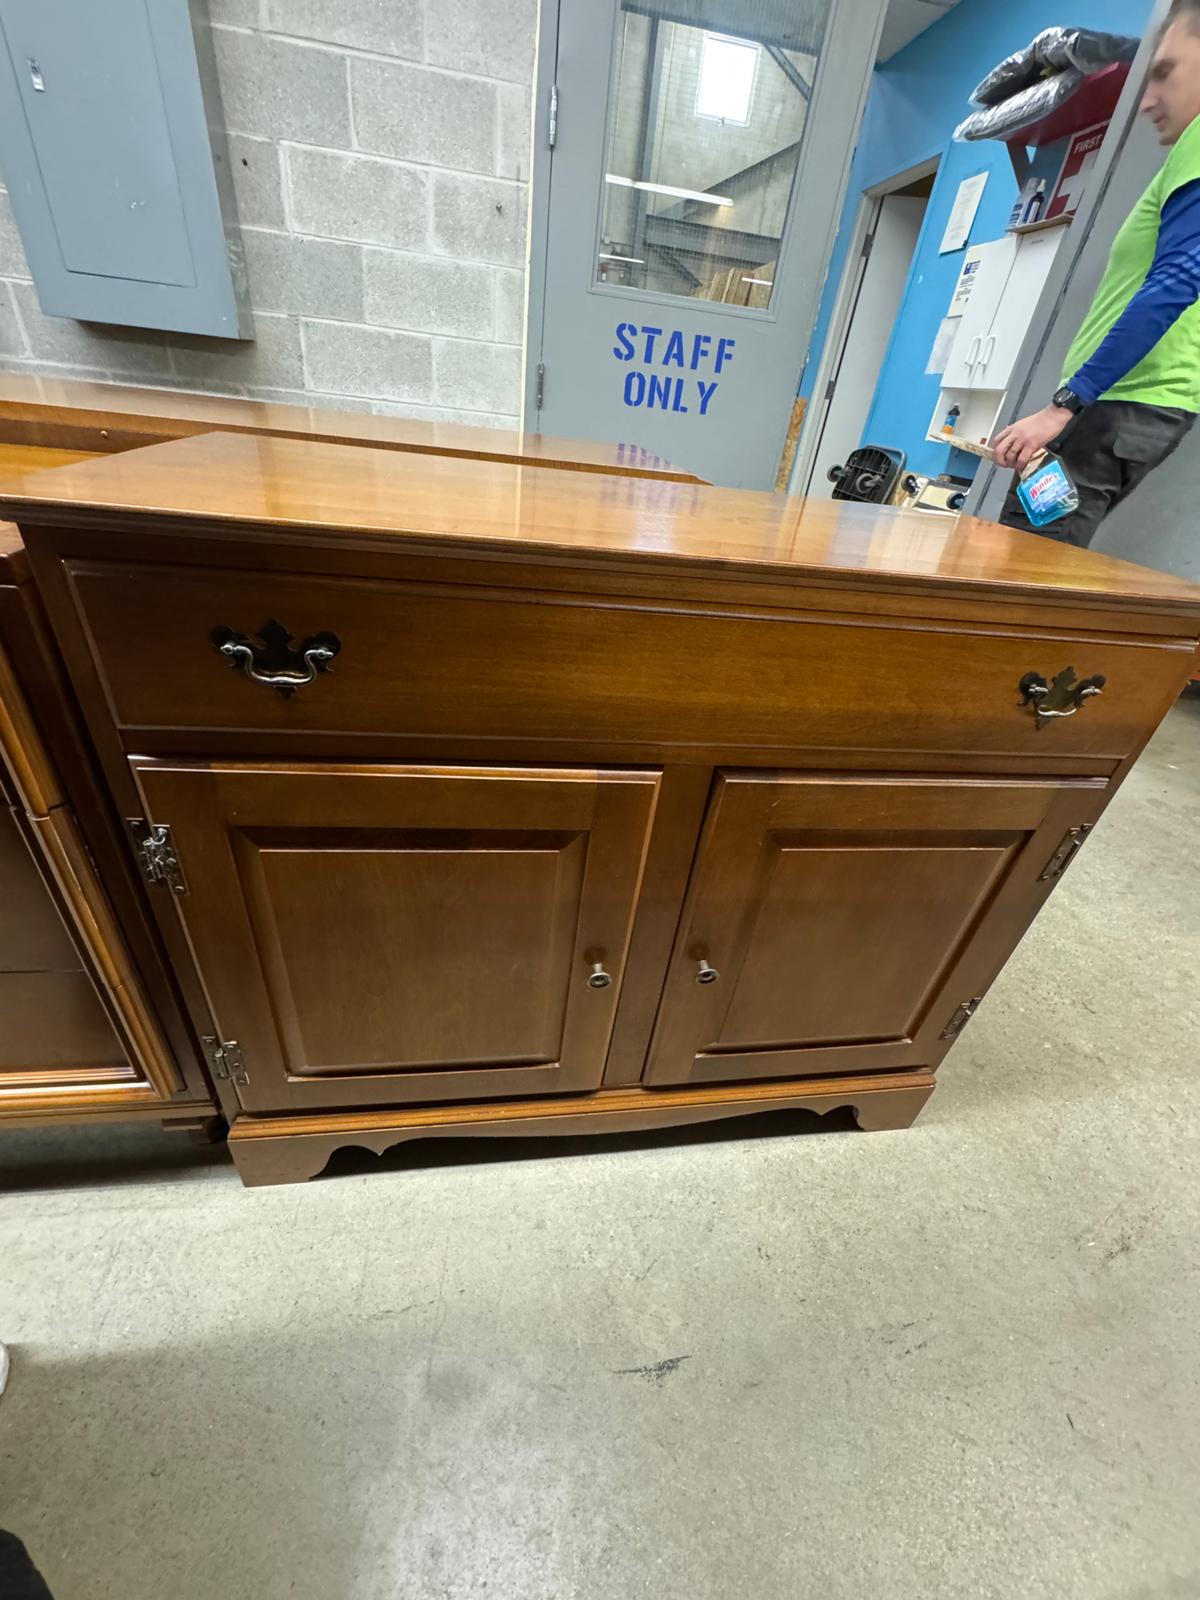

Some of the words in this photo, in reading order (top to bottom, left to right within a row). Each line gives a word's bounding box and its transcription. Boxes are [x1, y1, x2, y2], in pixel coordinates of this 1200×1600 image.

[1073, 134, 1103, 153] FIRST
[613, 322, 735, 373] STAFF
[624, 371, 718, 415] ONLY
